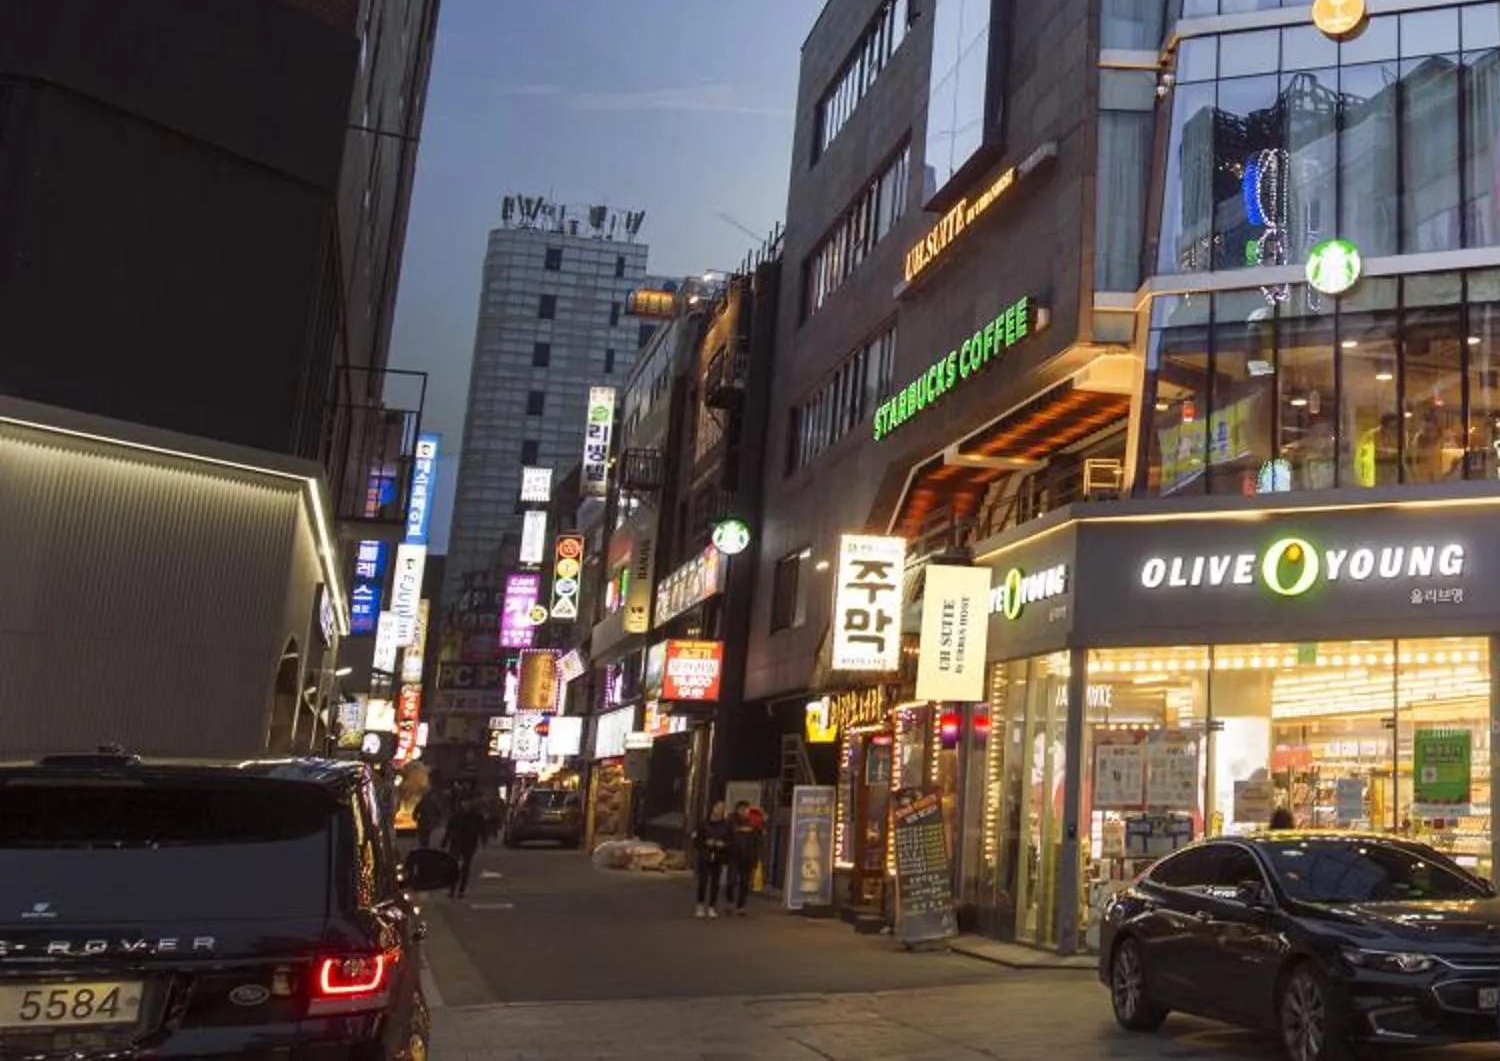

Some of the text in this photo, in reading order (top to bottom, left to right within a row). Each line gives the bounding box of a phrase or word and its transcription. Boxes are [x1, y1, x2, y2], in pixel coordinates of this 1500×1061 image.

[873, 295, 1031, 442] STARBUCKS COFFEE
[1140, 543, 1465, 589] OLIVE YOUNG
[843, 559, 898, 655] 주막
[1409, 587, 1464, 605] 올리브영
[941, 599, 955, 648] SUITE
[46, 935, 216, 957] ROVER
[18, 987, 121, 1022] 5584
